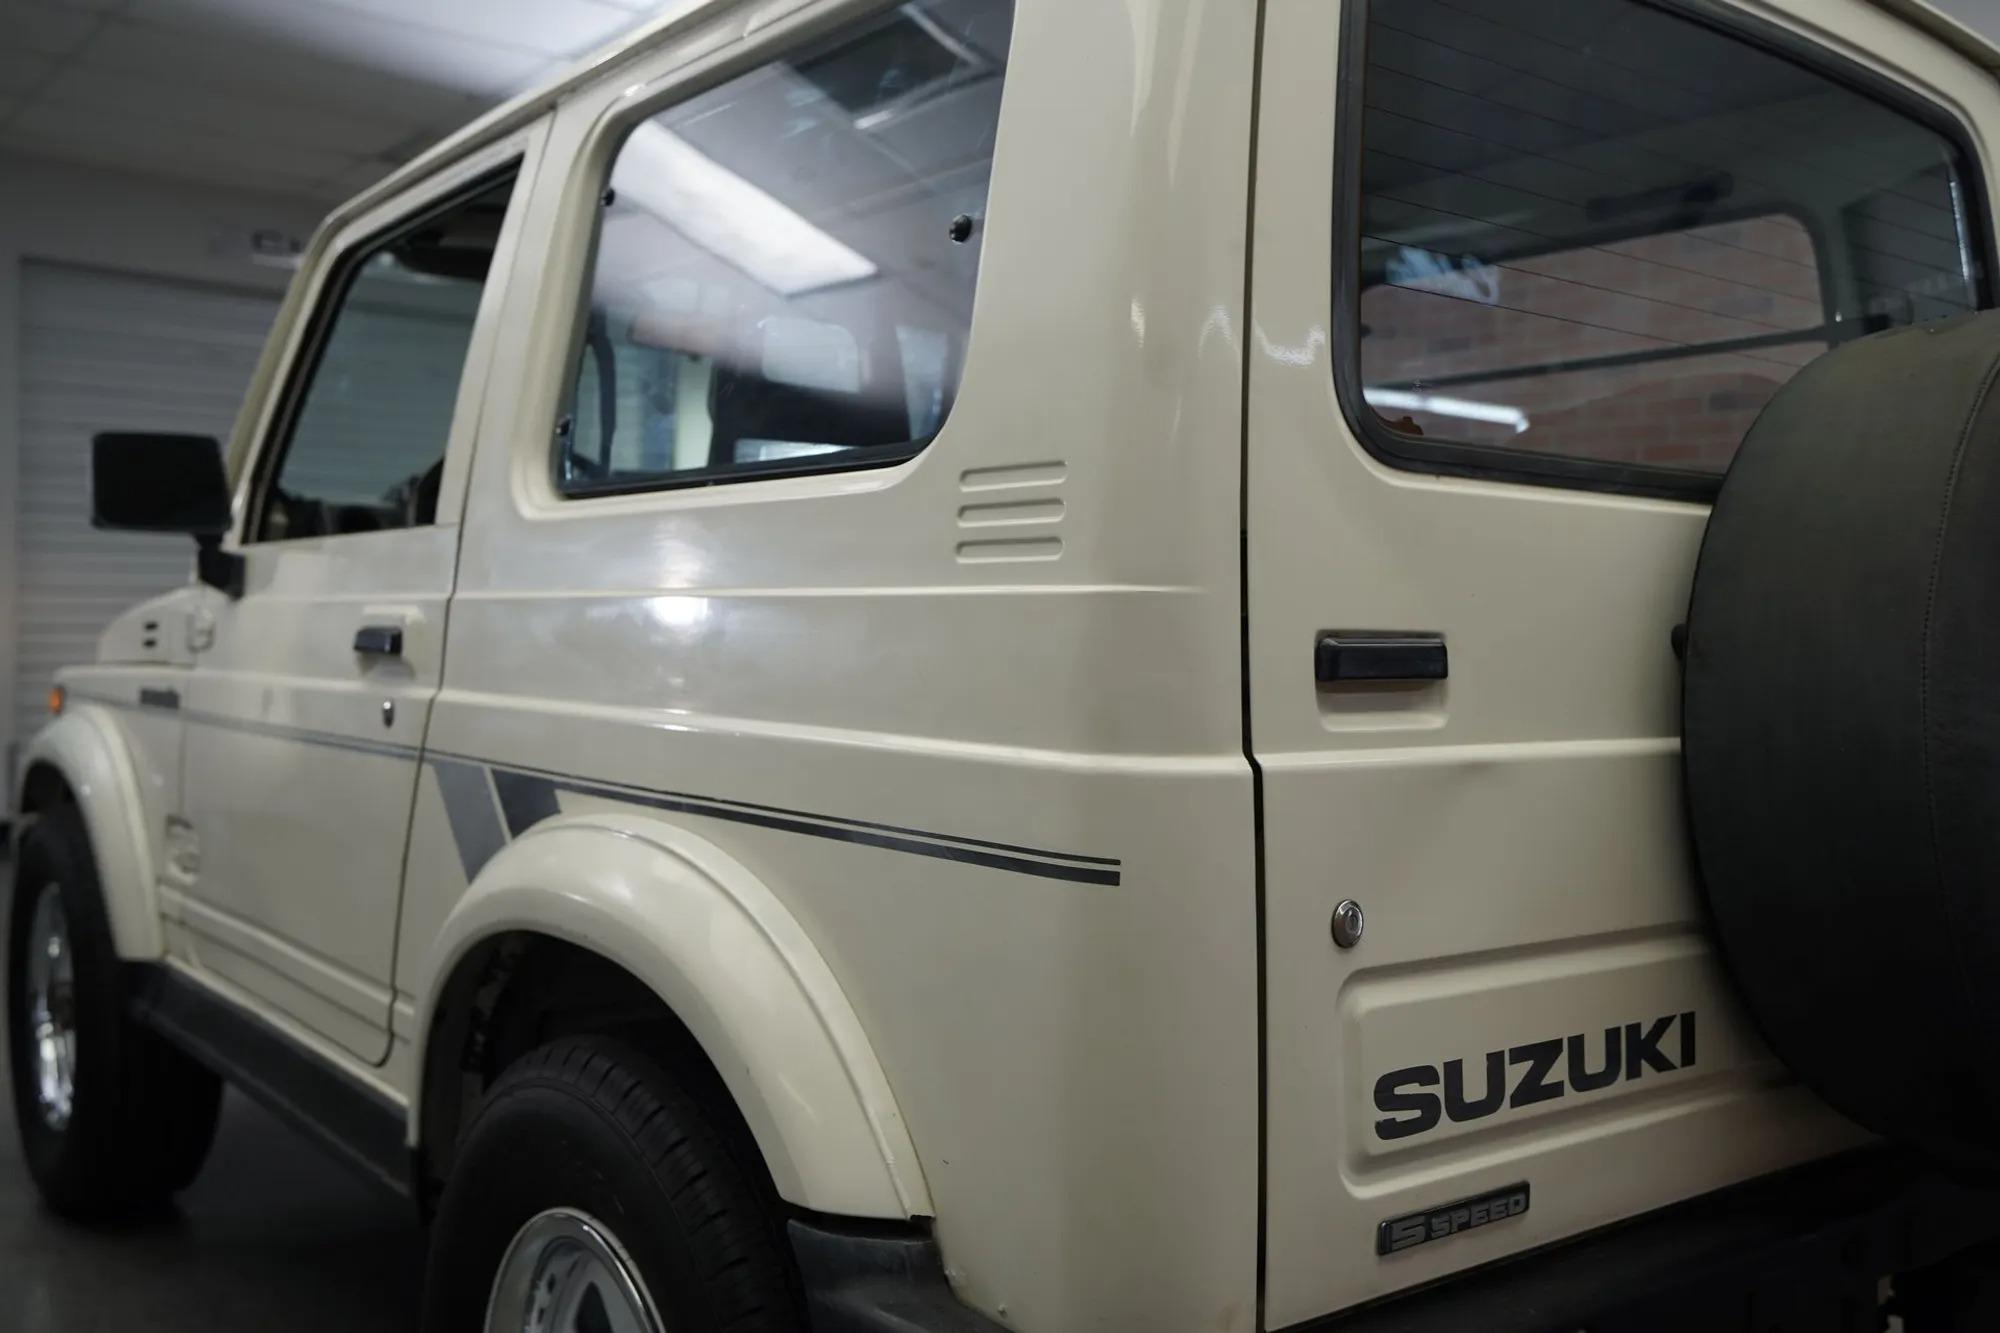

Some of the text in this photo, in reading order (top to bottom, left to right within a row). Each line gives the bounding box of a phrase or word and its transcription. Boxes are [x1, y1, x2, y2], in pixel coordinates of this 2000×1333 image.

[1374, 1011, 1696, 1140] SUZUKI
[1391, 1192, 1526, 1251] 5 SPEED
